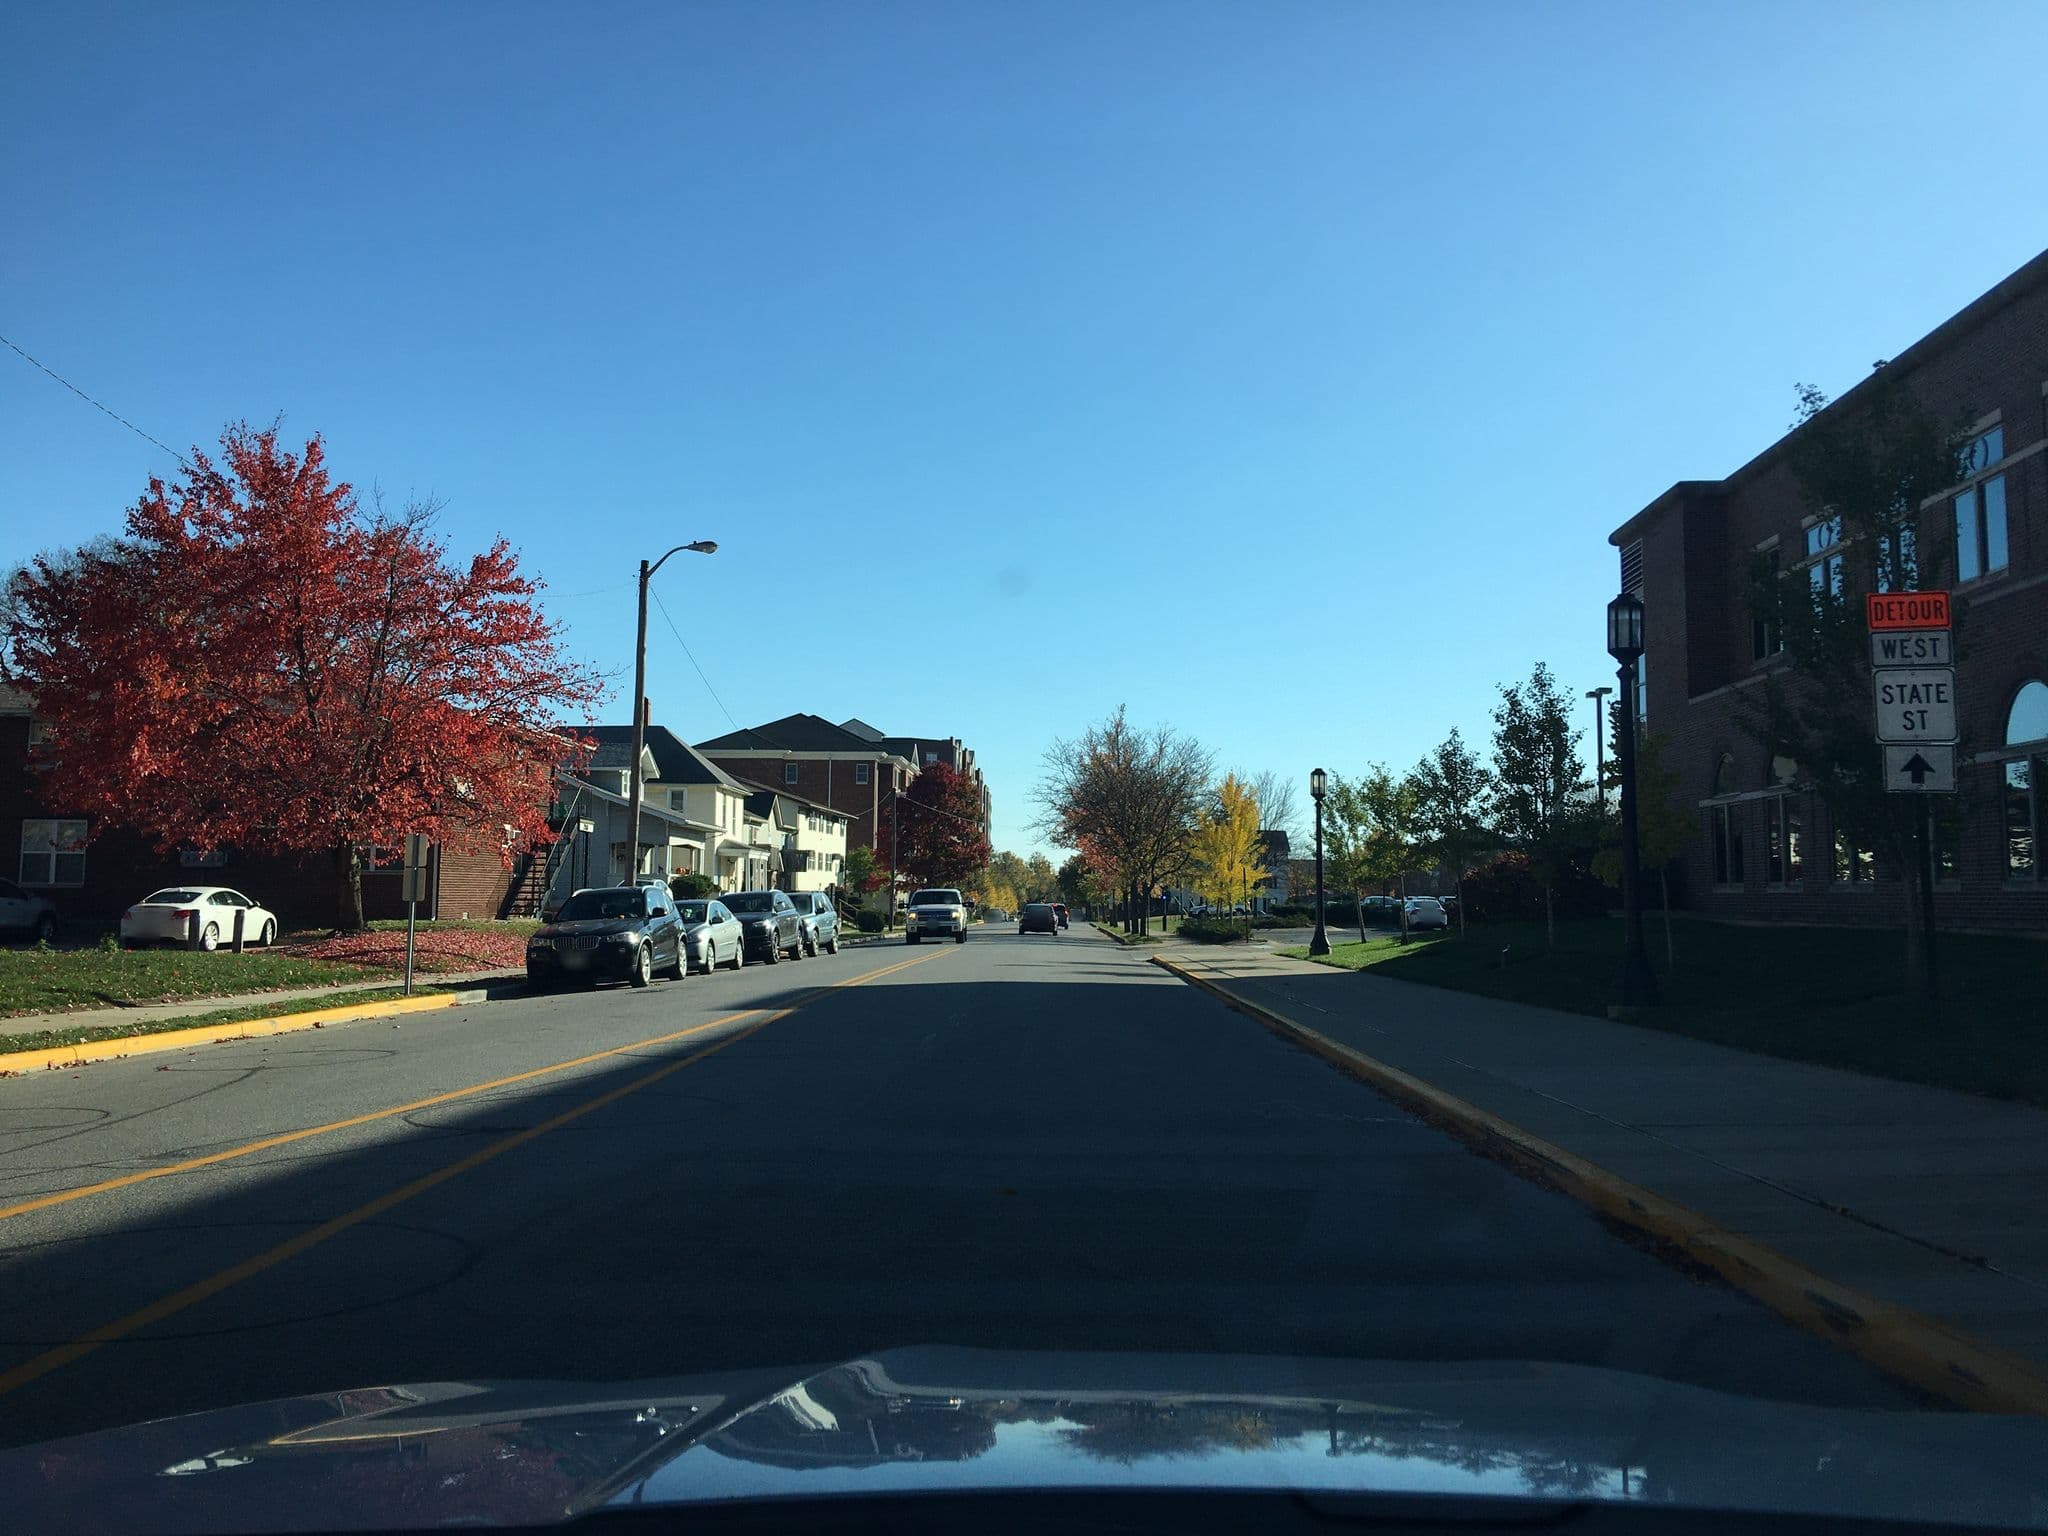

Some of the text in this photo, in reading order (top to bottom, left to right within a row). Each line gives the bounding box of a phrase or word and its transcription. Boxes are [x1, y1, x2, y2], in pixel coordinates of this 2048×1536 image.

[1873, 600, 1944, 621] DETOUR
[1881, 638, 1940, 659] WEST
[1881, 683, 1949, 705] STATE
[1902, 710, 1929, 731] ST
